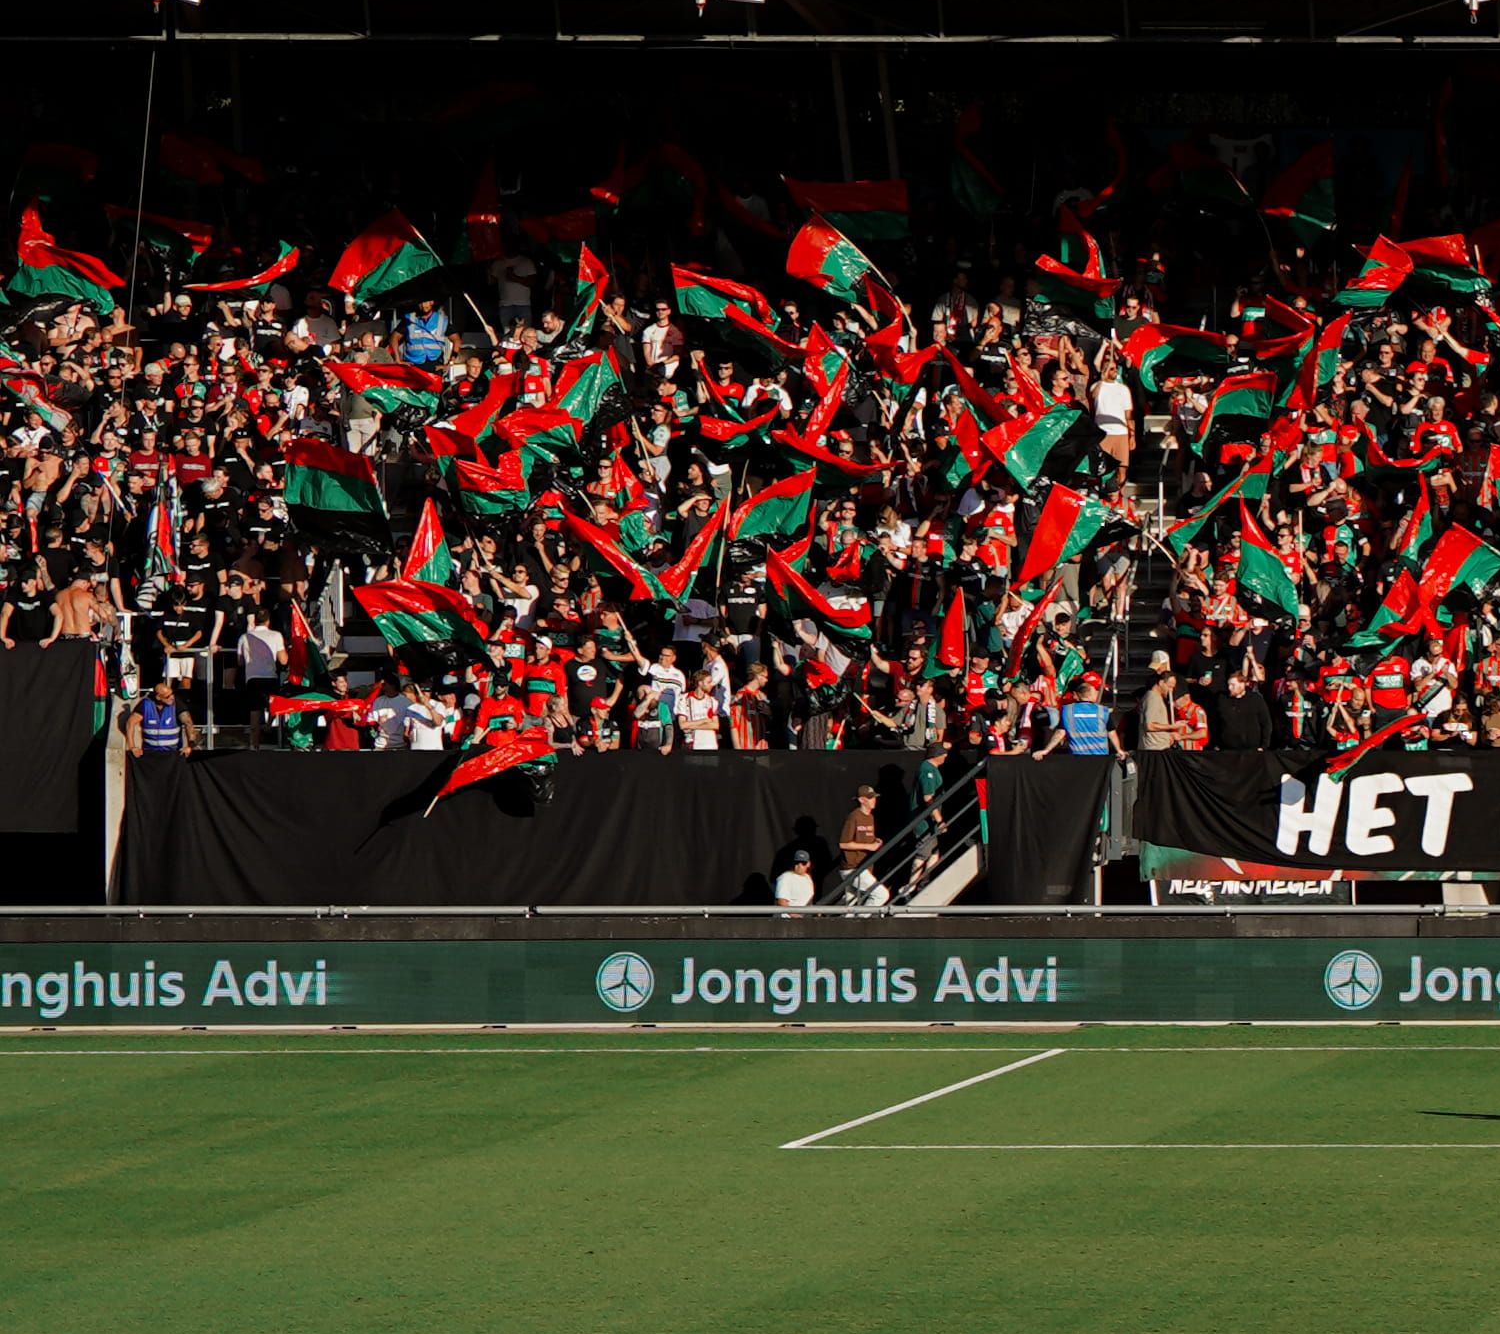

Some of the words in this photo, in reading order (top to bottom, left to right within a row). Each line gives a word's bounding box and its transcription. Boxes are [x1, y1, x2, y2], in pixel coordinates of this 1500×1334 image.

[1276, 773, 1473, 856] HET
[202, 960, 327, 1006] Advi
[672, 957, 917, 1014] Jonghuis
[934, 957, 1057, 1002] Advi
